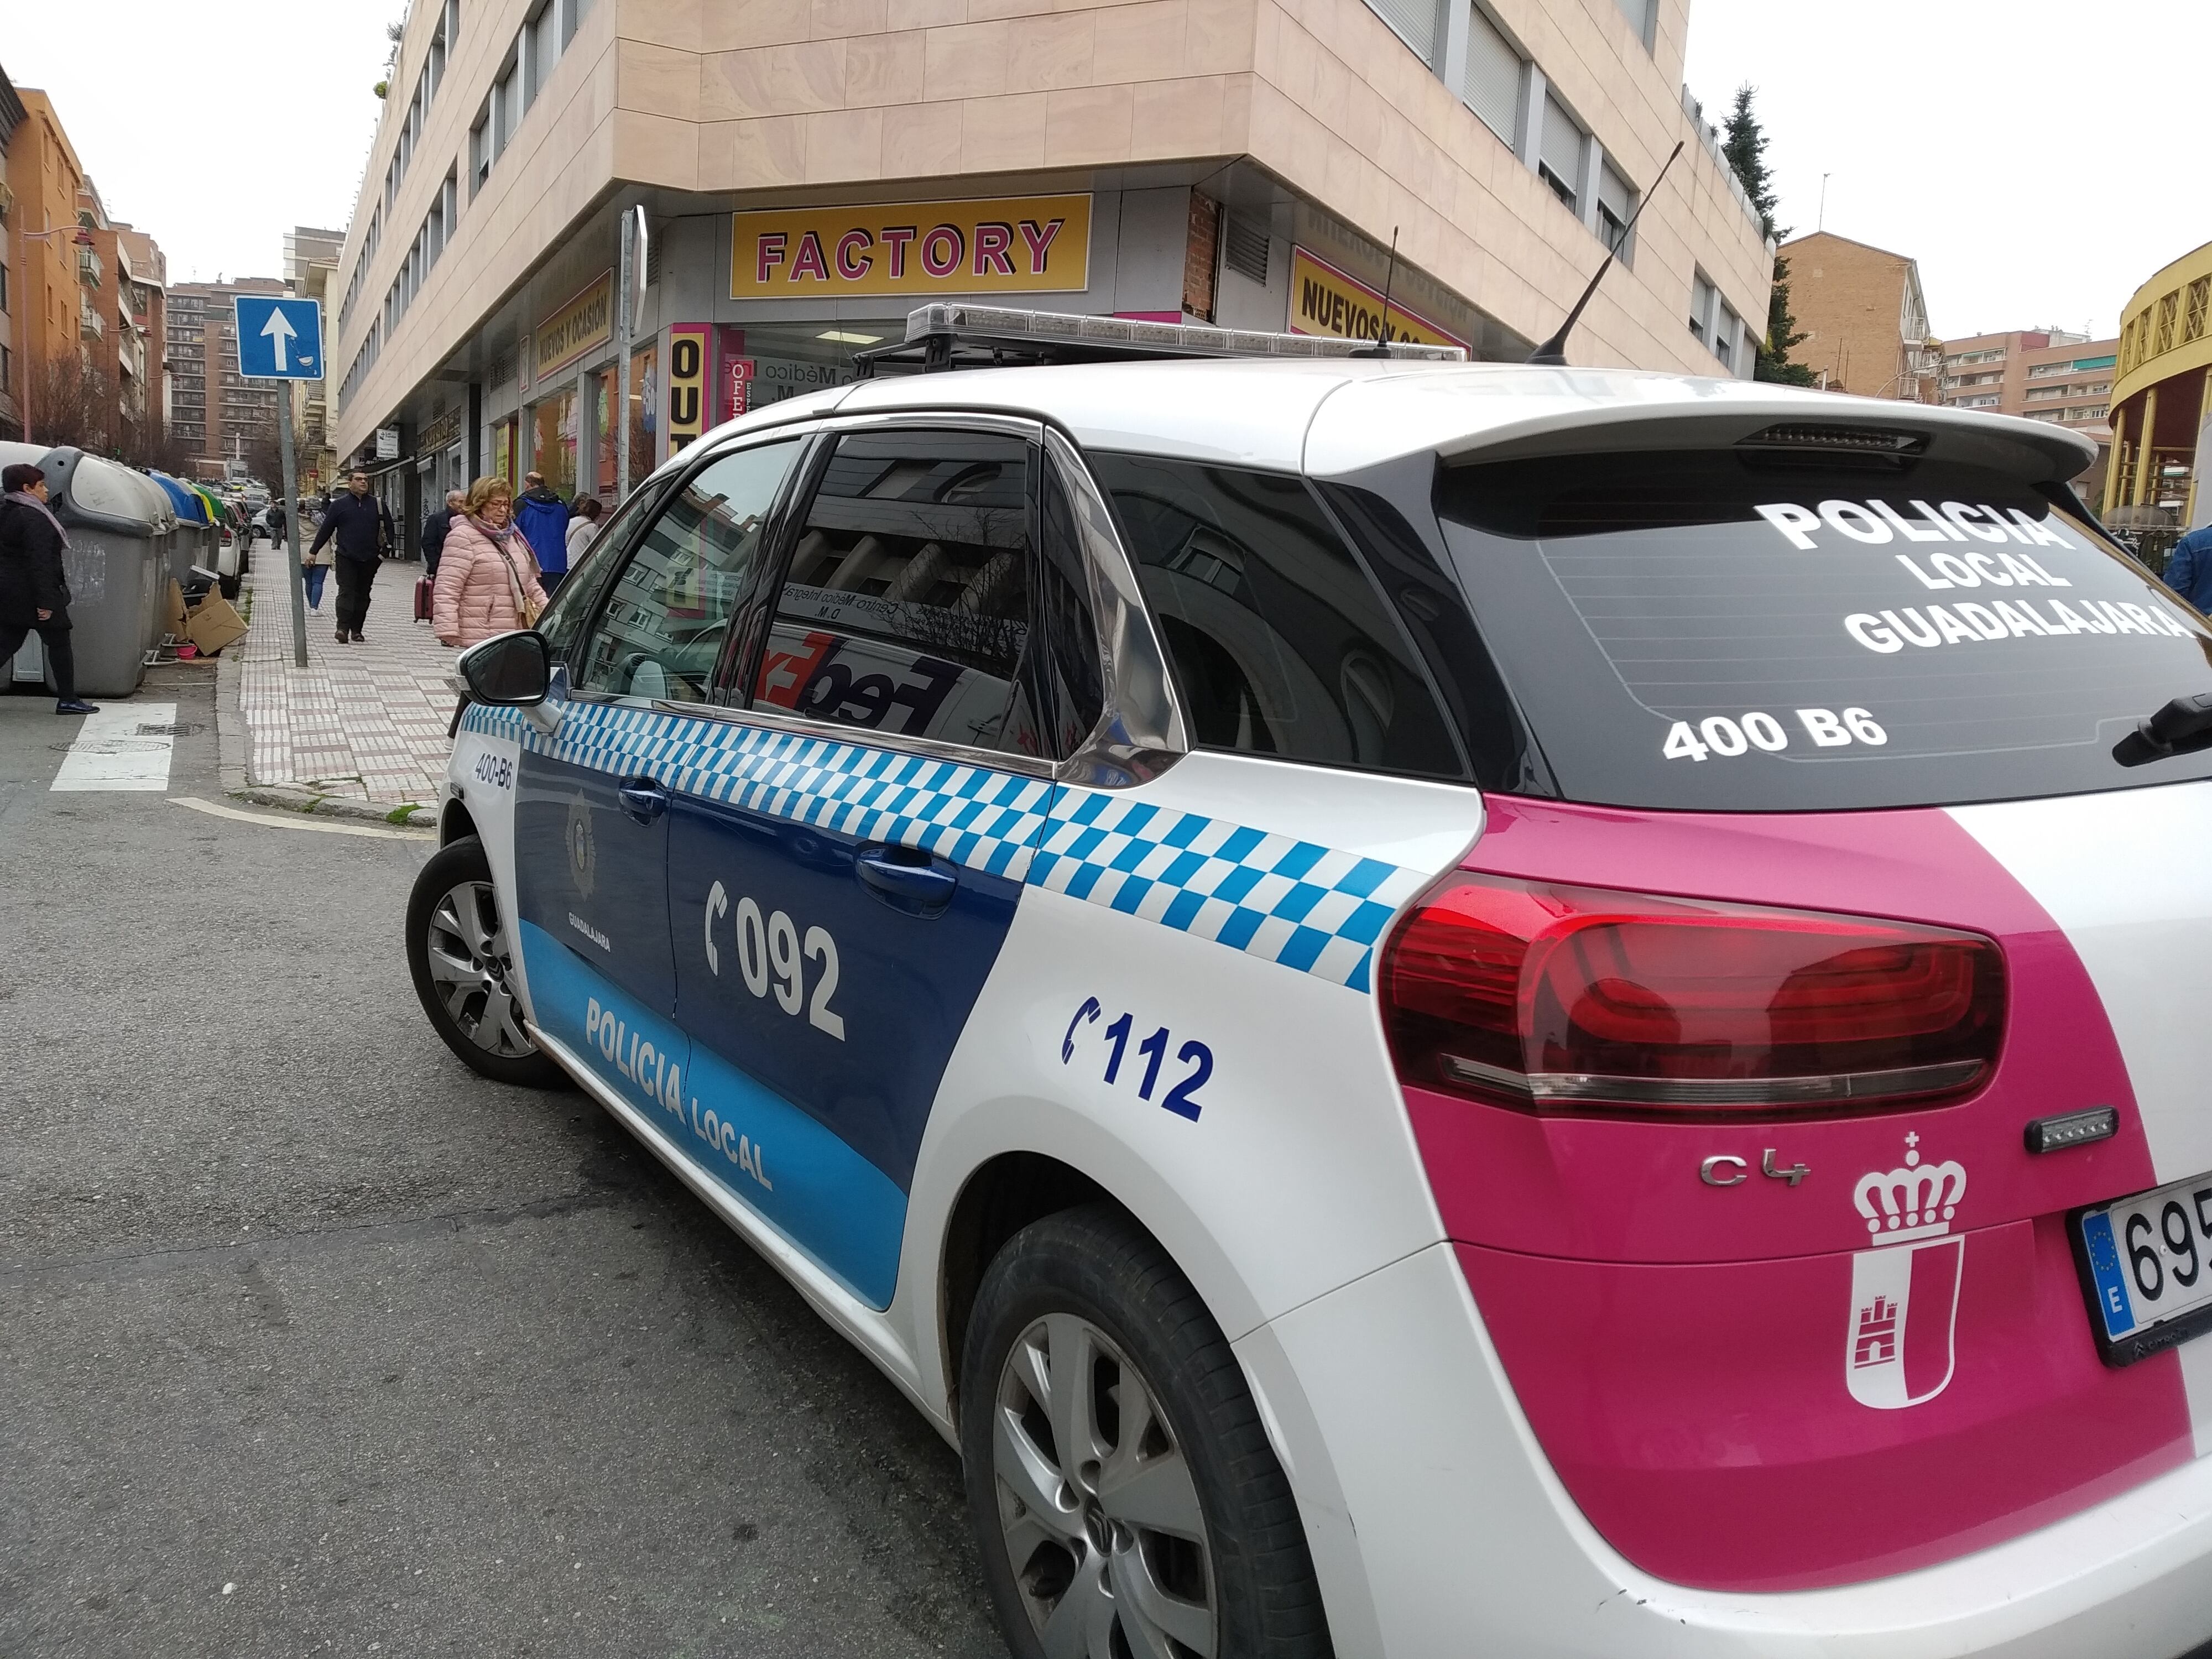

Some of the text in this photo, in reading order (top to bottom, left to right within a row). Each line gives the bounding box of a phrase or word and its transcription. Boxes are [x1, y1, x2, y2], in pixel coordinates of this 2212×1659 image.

[755, 218, 1066, 284] FACTORY
[539, 289, 607, 366] NUEVOS Y OCASIÓN
[1301, 276, 1380, 340] NUEVOS
[1754, 499, 2077, 551] POLICIA
[1895, 552, 2073, 590] LOCAL
[1843, 599, 2198, 654] GUADALAJARA
[1662, 707, 1888, 763] 400 B6
[475, 753, 513, 791] 400-B6
[568, 911, 611, 953] GUADALAJARA
[735, 897, 846, 1042] 092
[585, 997, 773, 1192] POLICIA LOCAL
[1104, 1012, 1213, 1123] 112
[2107, 1286, 2123, 1314] E
